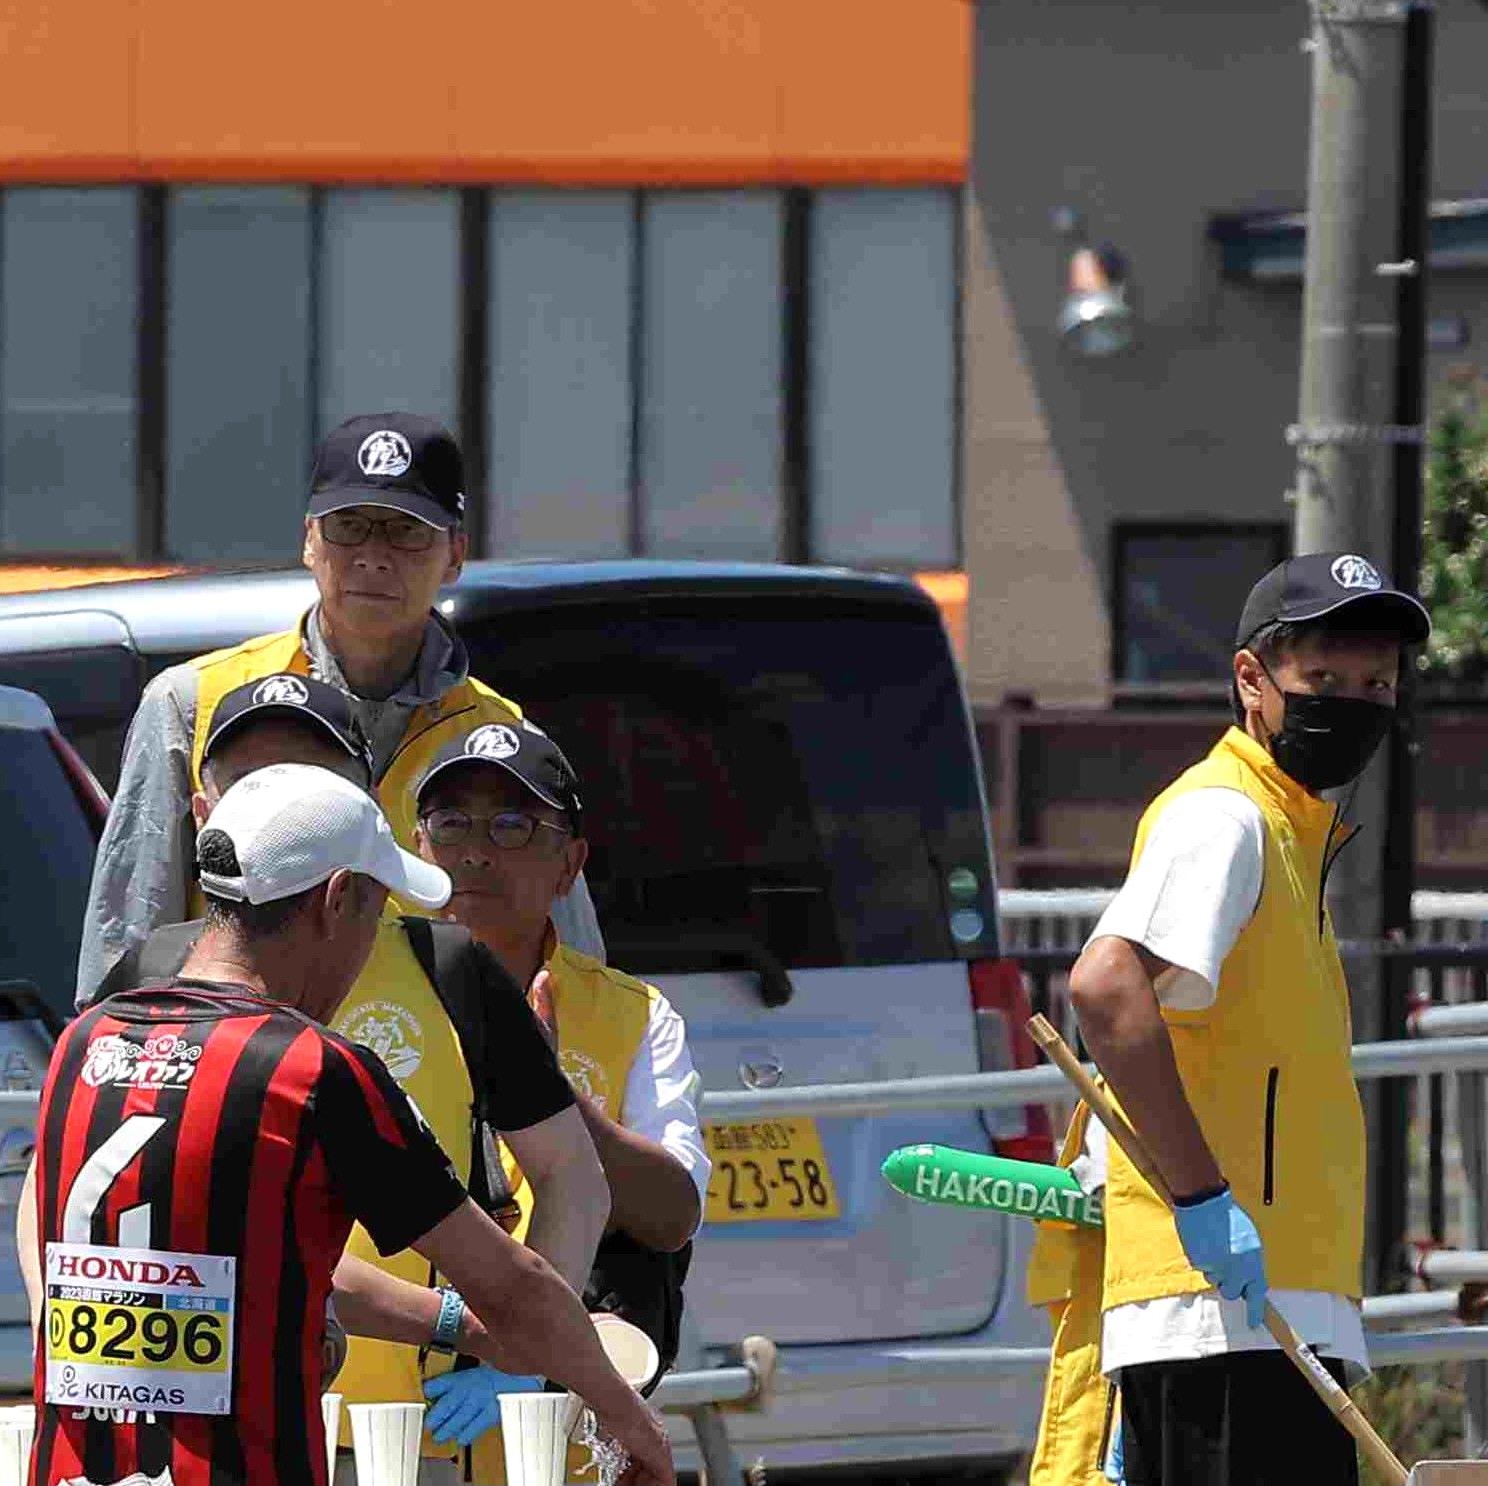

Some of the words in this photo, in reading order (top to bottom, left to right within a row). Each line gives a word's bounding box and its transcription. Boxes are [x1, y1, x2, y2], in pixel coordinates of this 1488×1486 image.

[915, 1165, 1103, 1225] HAKODATE
[58, 1254, 205, 1288] HONDA
[69, 1305, 222, 1364] 8296
[85, 1383, 185, 1405] KITAGAS
